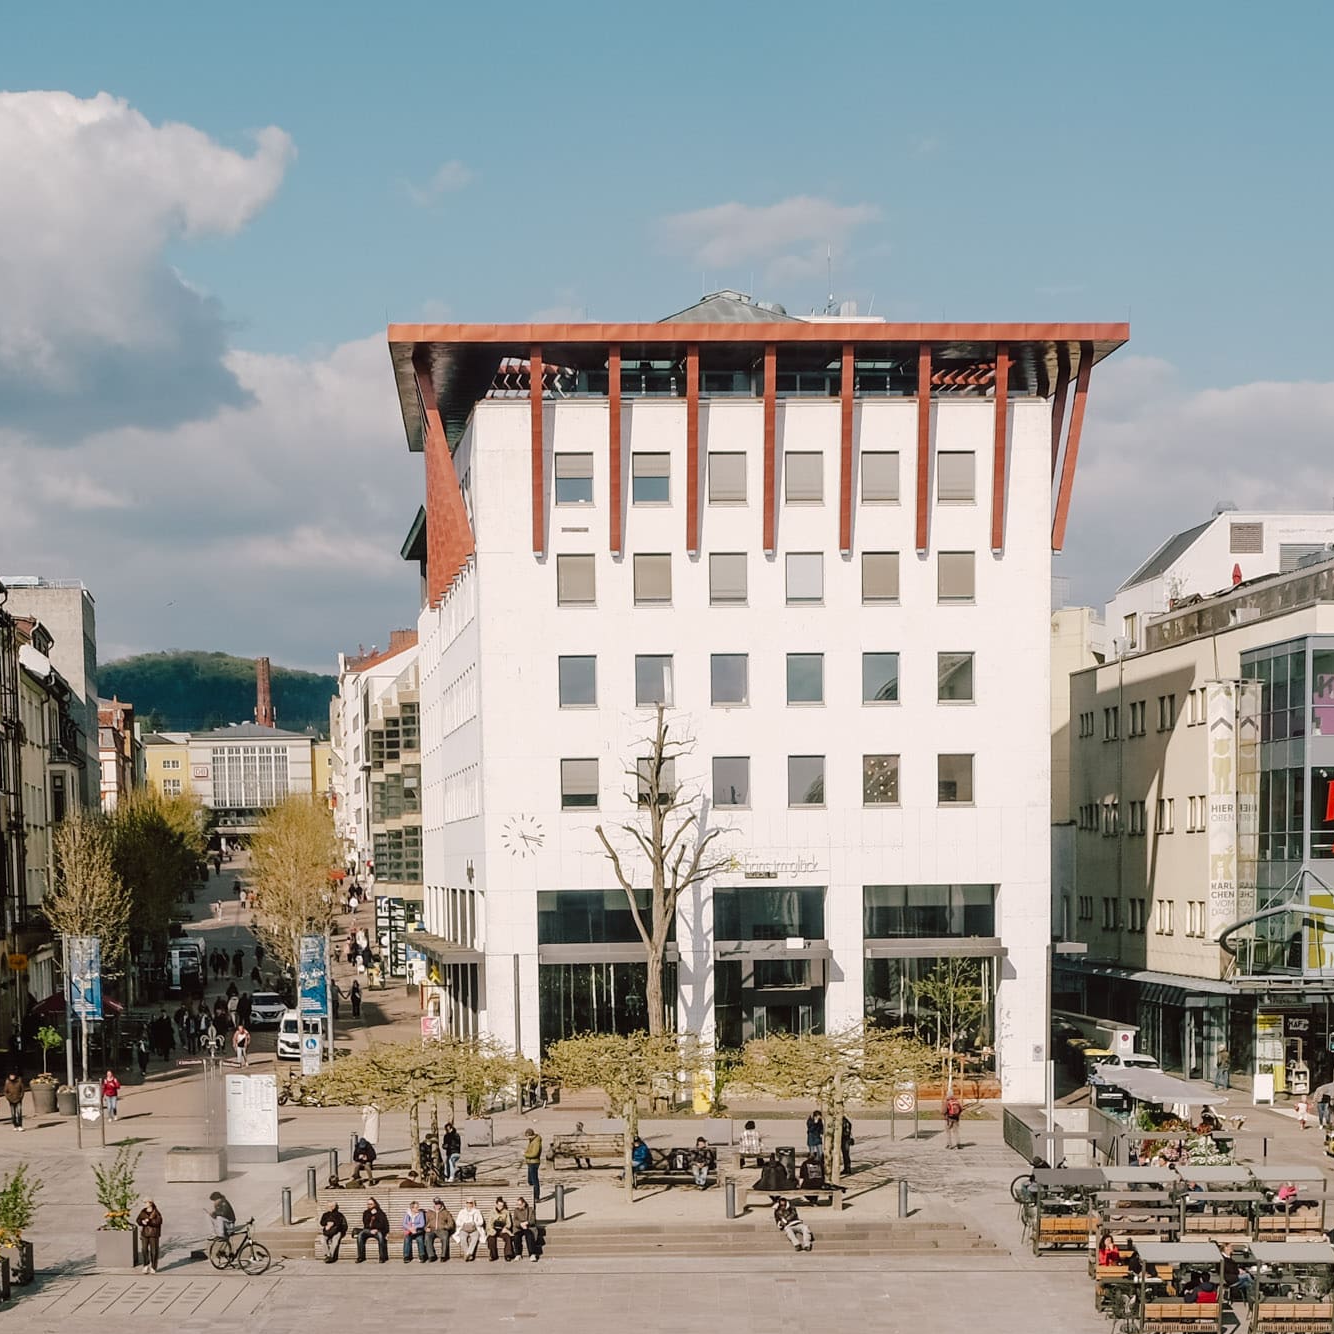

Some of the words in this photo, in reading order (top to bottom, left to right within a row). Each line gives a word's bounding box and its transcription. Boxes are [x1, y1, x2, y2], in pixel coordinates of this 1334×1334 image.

[1211, 804, 1234, 813] HIER
[1211, 882, 1234, 890] KARL
[1211, 891, 1235, 899] CHEN
